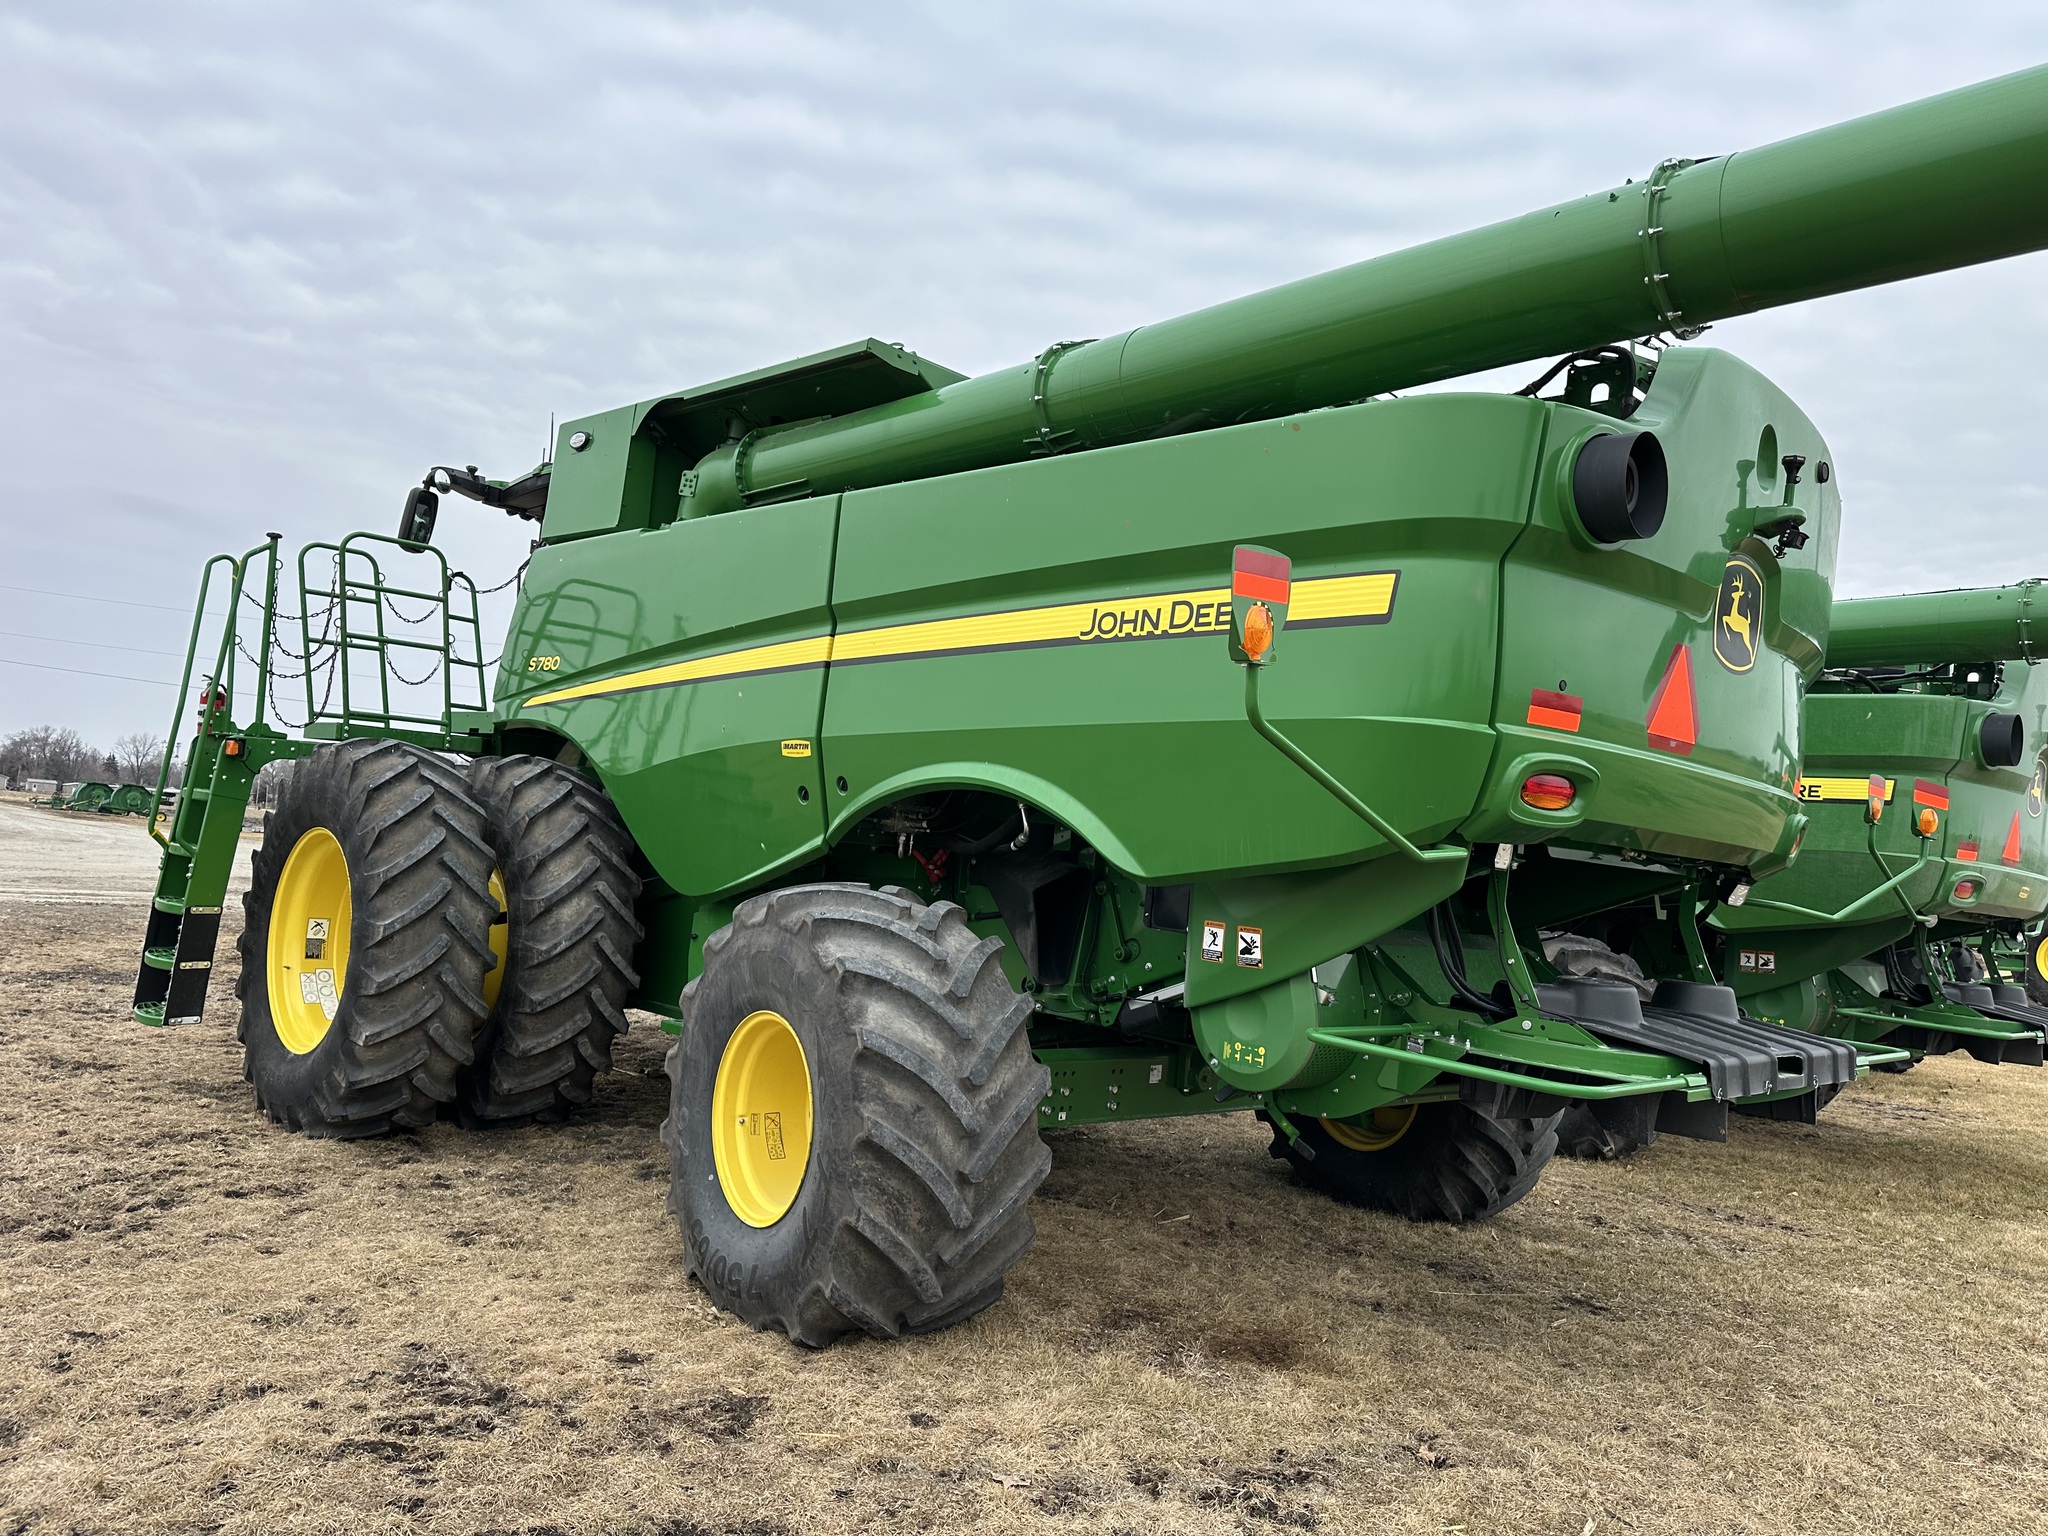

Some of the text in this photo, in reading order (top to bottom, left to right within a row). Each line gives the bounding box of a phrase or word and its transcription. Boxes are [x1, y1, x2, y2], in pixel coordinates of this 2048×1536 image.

[1080, 600, 1232, 637] JOHN DEE
[527, 655, 561, 672] S780
